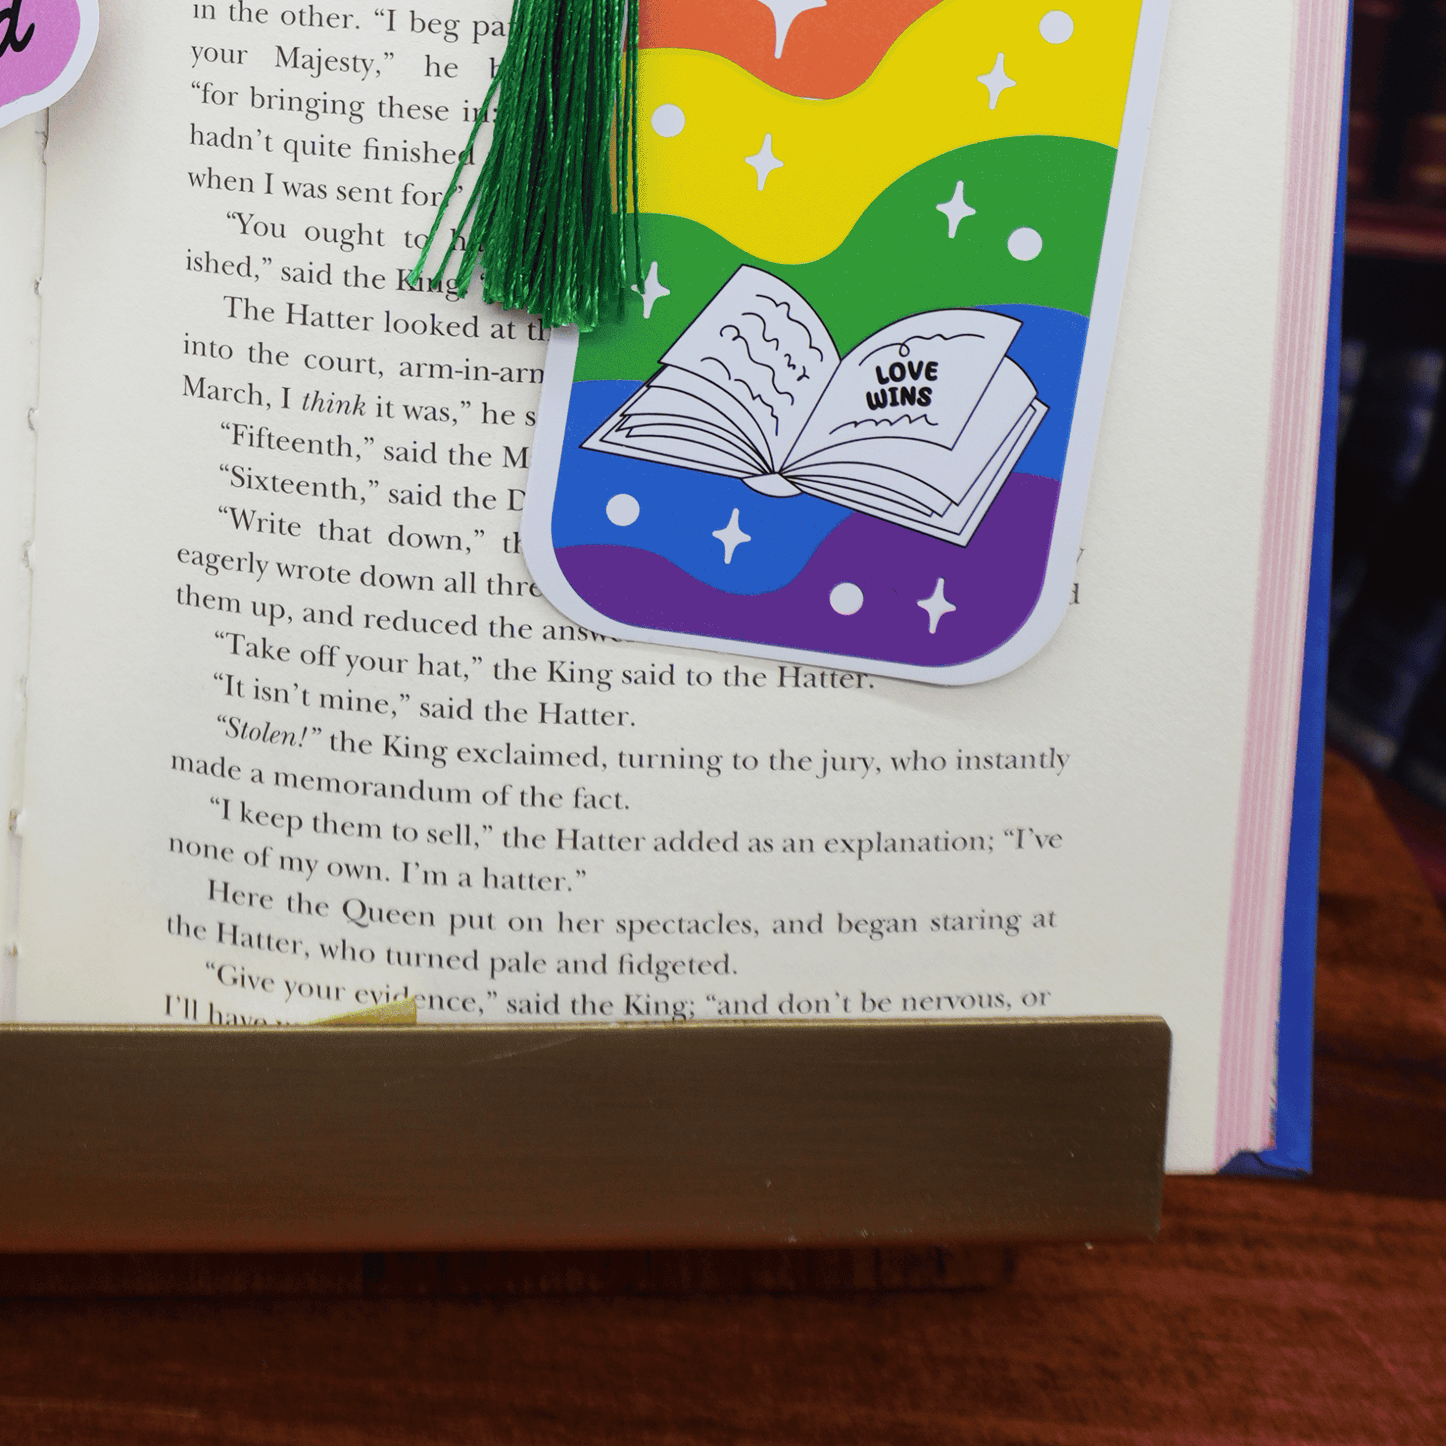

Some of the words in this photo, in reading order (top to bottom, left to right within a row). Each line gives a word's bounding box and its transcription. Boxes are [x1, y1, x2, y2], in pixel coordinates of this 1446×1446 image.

[187, 166, 255, 194] when
[263, 171, 274, 195] I
[281, 180, 328, 200] was
[336, 185, 394, 205] sent
[223, 295, 275, 323] The
[285, 301, 375, 332] Hatter
[383, 309, 480, 339] looked
[489, 318, 518, 342] at
[876, 360, 939, 385] LOVE
[182, 374, 272, 411] March,
[280, 386, 291, 410] I
[301, 389, 367, 417] think
[375, 395, 395, 419] it
[402, 399, 472, 427] was,”
[481, 401, 516, 426] he
[866, 386, 932, 410] WINS
[220, 421, 375, 463] “Fifteenth,”
[219, 463, 380, 506] “Sixteenth,”
[213, 671, 246, 699] “It
[253, 682, 311, 707] isn’t
[319, 688, 411, 720] mine,”
[419, 696, 474, 721] said
[484, 699, 529, 724] the
[537, 701, 636, 727] Hatter.
[208, 878, 274, 910] Here
[287, 891, 330, 917] the
[341, 898, 436, 929] Queen
[449, 912, 494, 937] put
[507, 916, 544, 933] on
[557, 910, 605, 934] her
[615, 912, 760, 943] spectacles,
[772, 912, 824, 935] and
[837, 912, 918, 941] began
[930, 908, 1023, 937] staring
[1032, 910, 1056, 929] at
